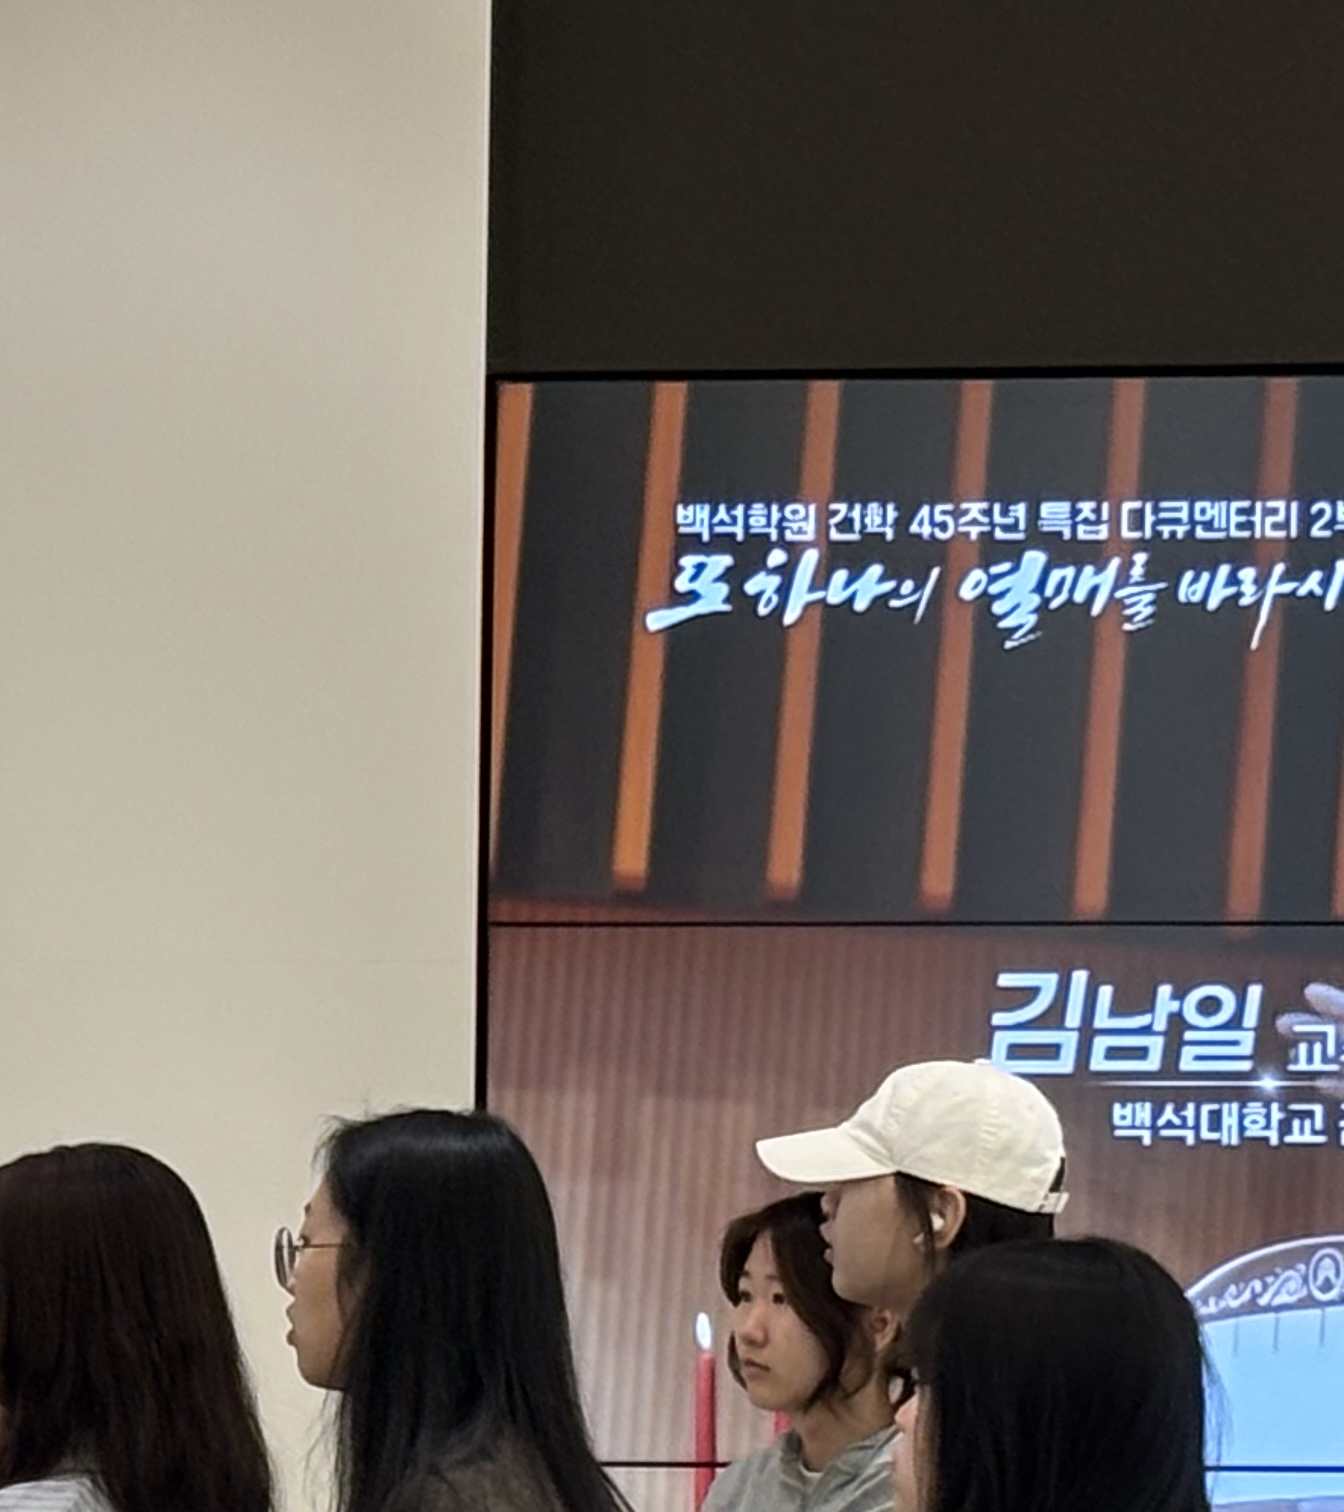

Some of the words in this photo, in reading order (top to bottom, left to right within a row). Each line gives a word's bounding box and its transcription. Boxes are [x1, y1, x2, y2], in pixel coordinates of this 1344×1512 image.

[675, 502, 817, 542] 백석학원
[827, 502, 899, 541] 건학
[909, 502, 1027, 541] 45주년
[1038, 501, 1110, 541] 특집
[1120, 500, 1298, 540] 다큐멘터리
[645, 554, 735, 633] 또
[743, 548, 942, 628] 하나의
[958, 550, 1169, 650] 열매를
[990, 969, 1264, 1075] 김남일
[1285, 1023, 1344, 1072] 교
[1112, 1102, 1329, 1147] 백석대학교
